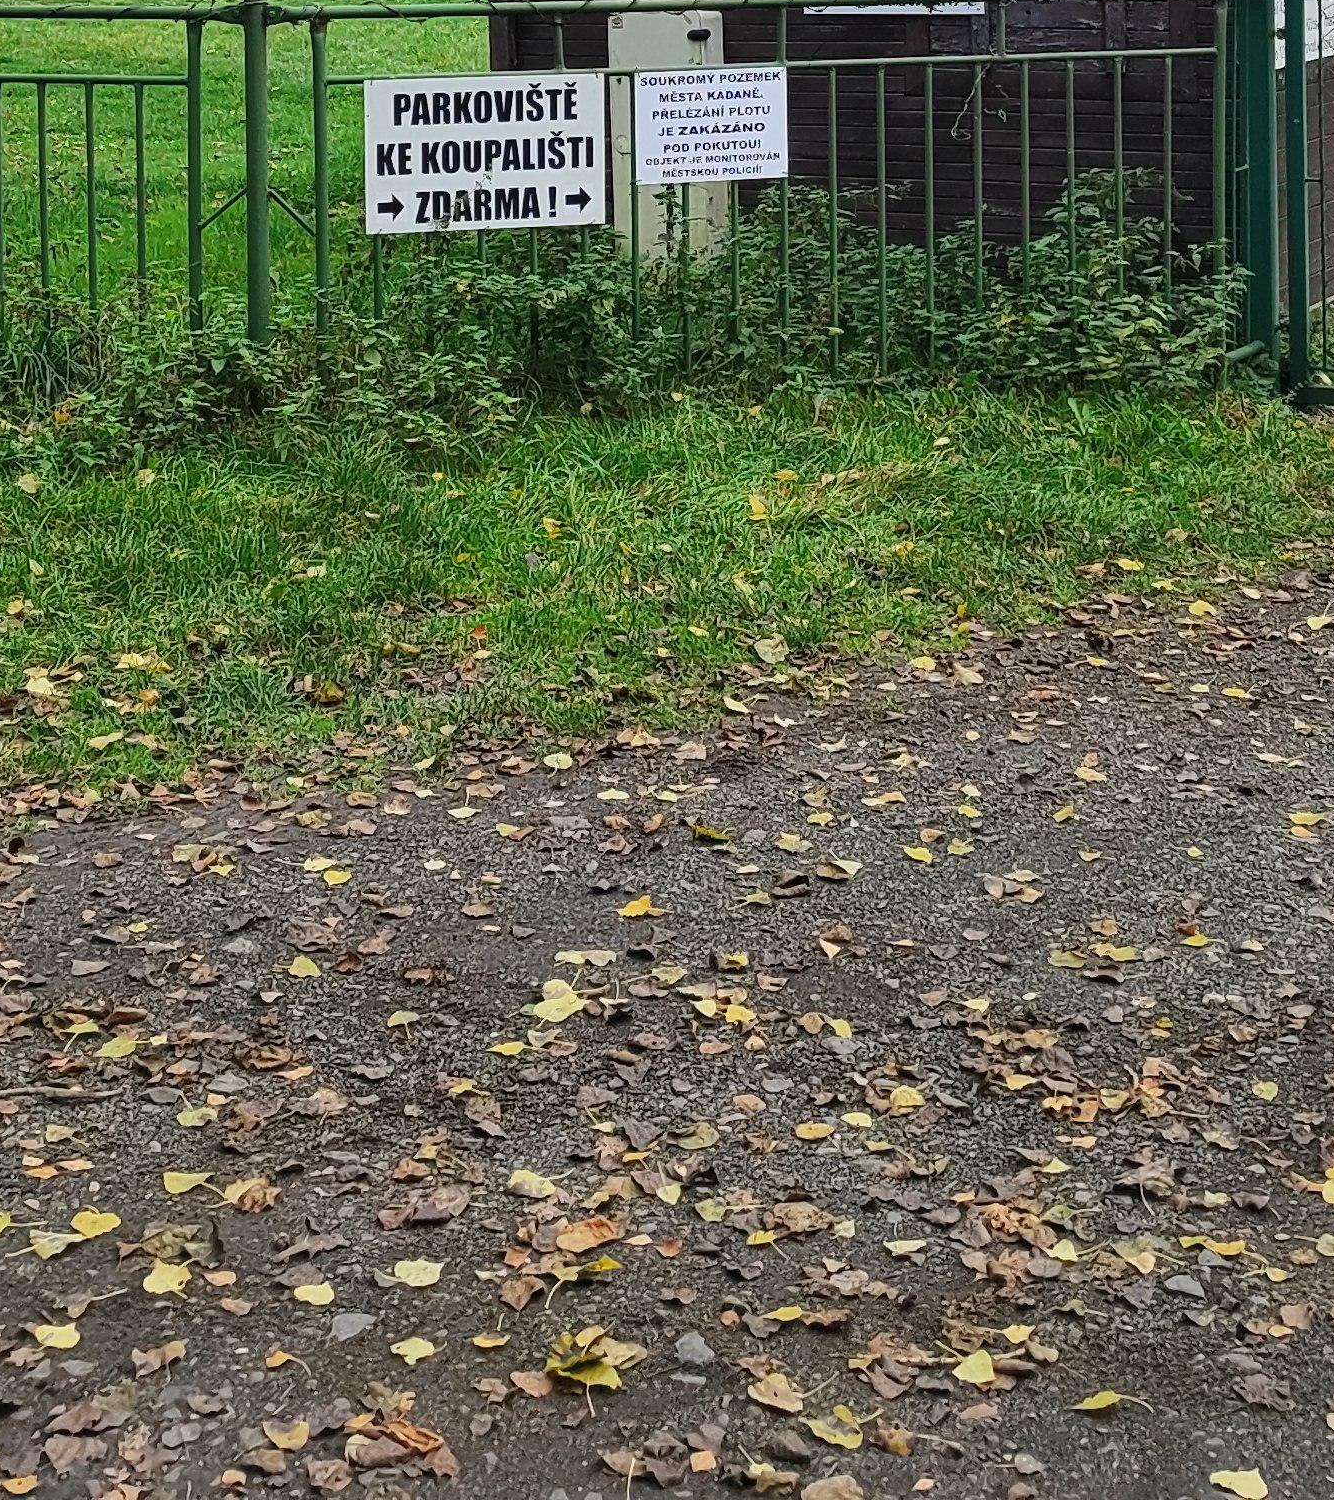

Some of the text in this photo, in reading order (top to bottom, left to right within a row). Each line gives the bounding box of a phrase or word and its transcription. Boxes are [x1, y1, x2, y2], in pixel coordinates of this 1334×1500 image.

[640, 71, 781, 87] SOUKROMÝ POZEMEK
[393, 82, 578, 126] PARKOVIŠTĚ
[659, 91, 703, 103] MĚSTA
[652, 105, 771, 120] PŘELÉZÁNÍ PLOTU
[658, 121, 765, 137] JE ZAKÁZÁNO
[376, 131, 594, 176] KE KOUPALIŠTI
[663, 143, 690, 154] POD
[645, 150, 780, 166] OBJEKT JE MONITOROVÁN
[662, 167, 719, 178] MĚSTSKOU
[415, 187, 541, 224] ZDARMA
